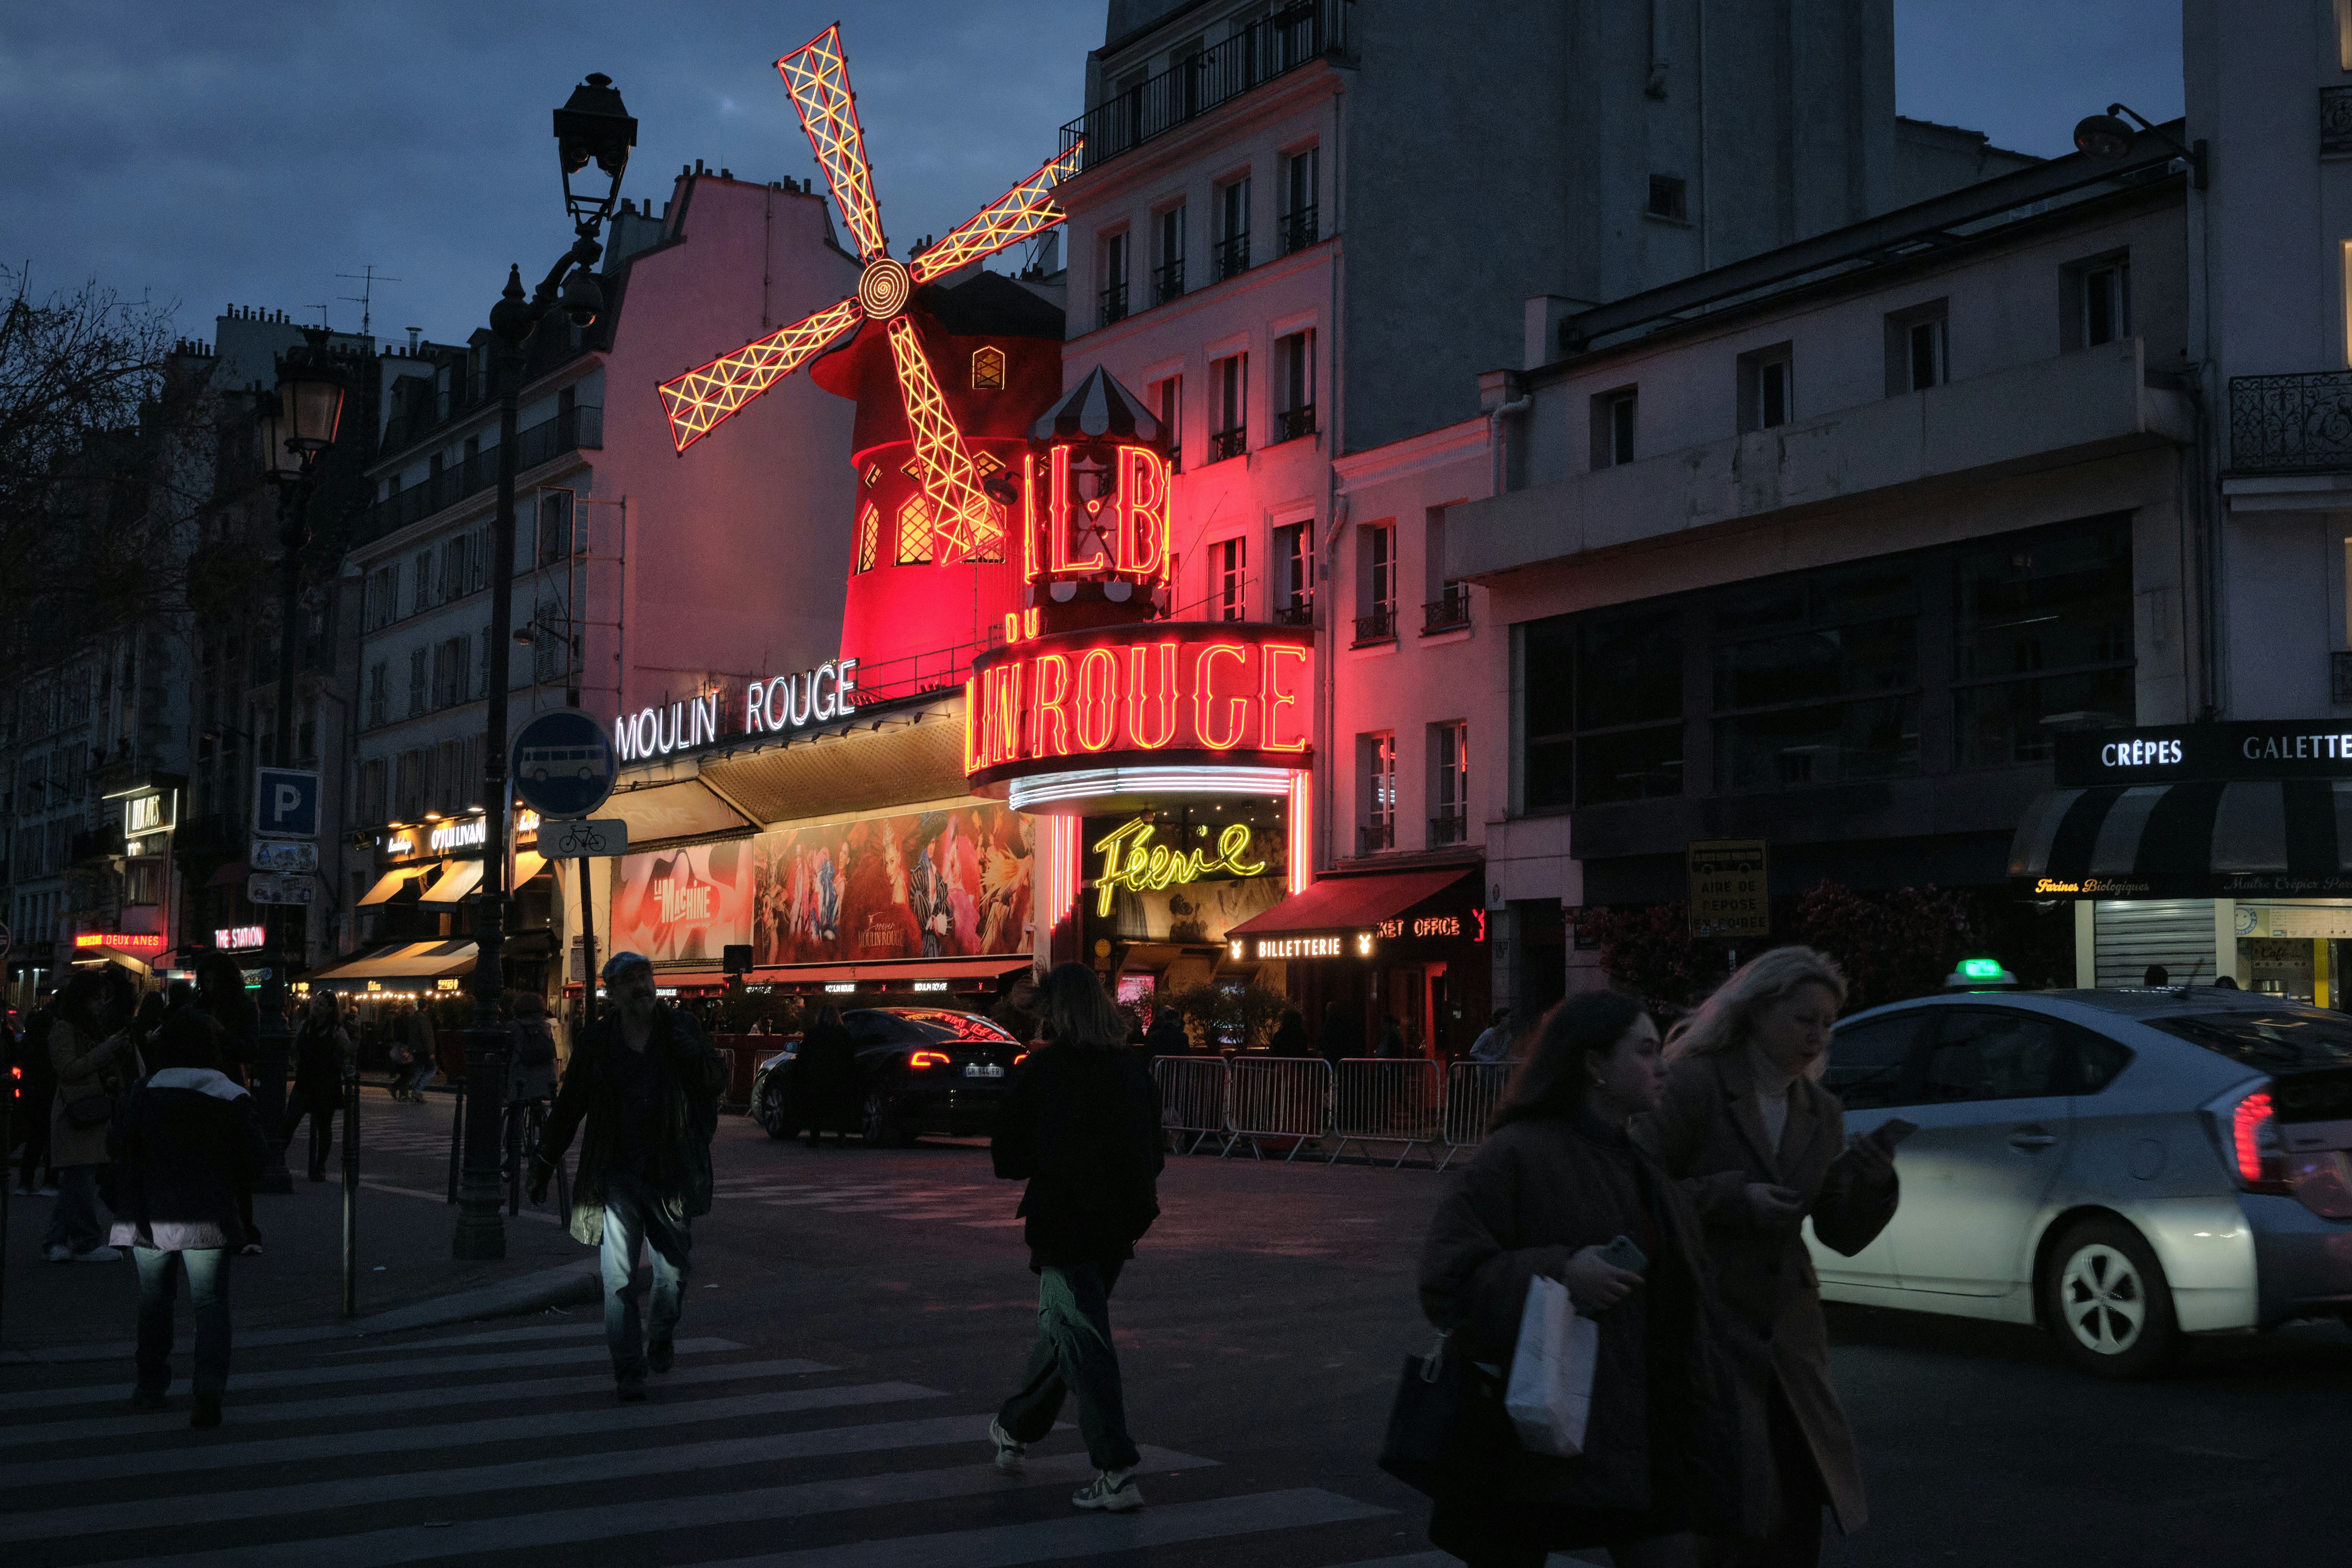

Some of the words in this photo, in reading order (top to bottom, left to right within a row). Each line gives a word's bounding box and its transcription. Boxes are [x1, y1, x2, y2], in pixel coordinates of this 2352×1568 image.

[1006, 608, 1038, 643] DU
[615, 693, 716, 761] MOULIN
[746, 658, 857, 735] ROUGE
[965, 662, 1020, 777] LIN
[1032, 643, 1306, 758] ROUGE
[2101, 739, 2183, 767] CRÊPES
[274, 783, 301, 822] P
[1701, 881, 1732, 893] AIRE
[1739, 881, 1755, 892] DE
[2035, 878, 2079, 893] Farines
[2082, 878, 2149, 896] Biologiques
[215, 929, 229, 949] THE
[232, 926, 262, 949] STATION
[858, 931, 882, 948] MOULIN
[882, 928, 904, 946] ROUGE
[1376, 918, 1404, 939] KET
[1414, 916, 1460, 938] OFFICE
[106, 935, 129, 945] DEUX
[133, 935, 159, 946] ANES
[1258, 938, 1340, 957] BILLETTERIE
